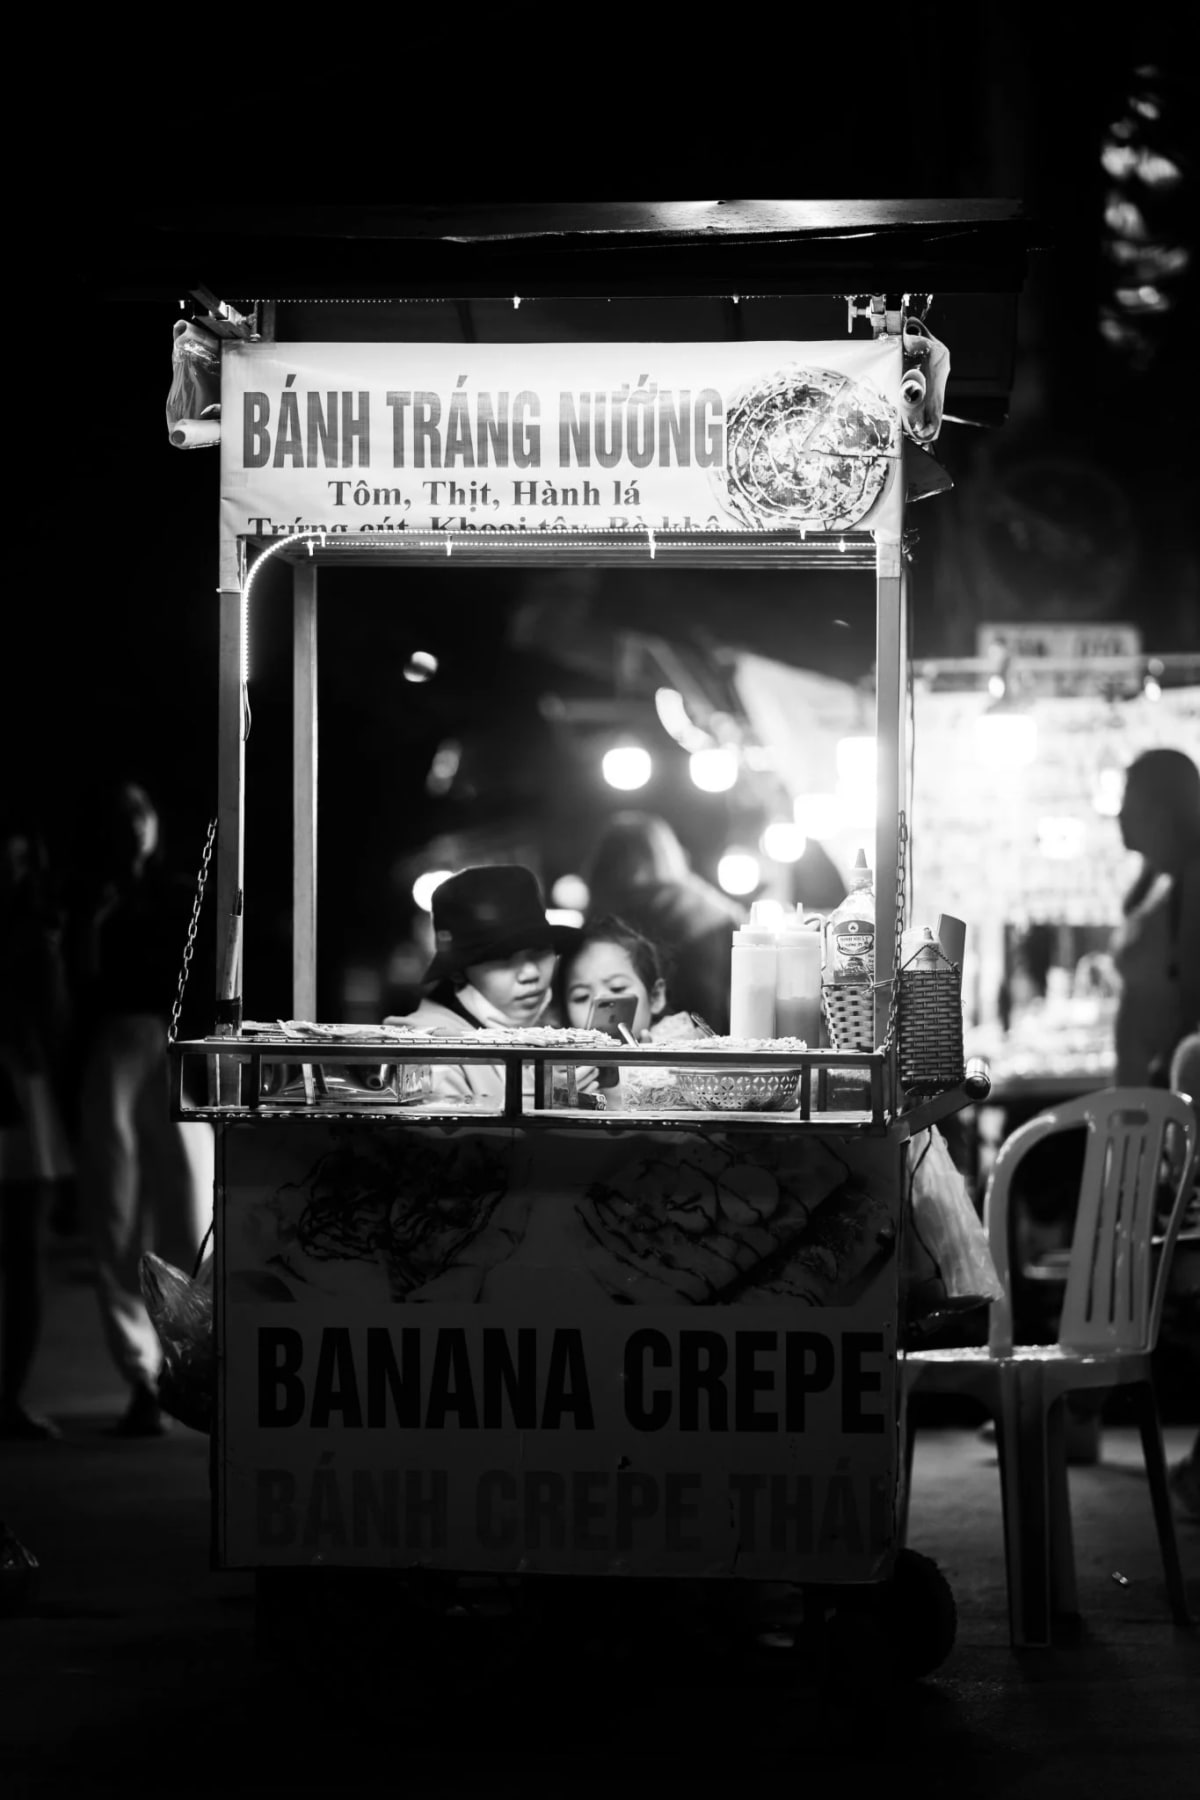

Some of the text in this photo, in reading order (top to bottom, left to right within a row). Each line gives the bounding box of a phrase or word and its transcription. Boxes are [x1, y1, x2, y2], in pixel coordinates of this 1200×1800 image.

[243, 373, 723, 469] BÁNH TRÁNG NƯỚNG
[328, 479, 641, 512] Tôm, Thịt, Hành lá
[258, 1327, 885, 1433] BANANA CREPE
[256, 1450, 448, 1550] BÁNH
[475, 1468, 703, 1553] CREPE
